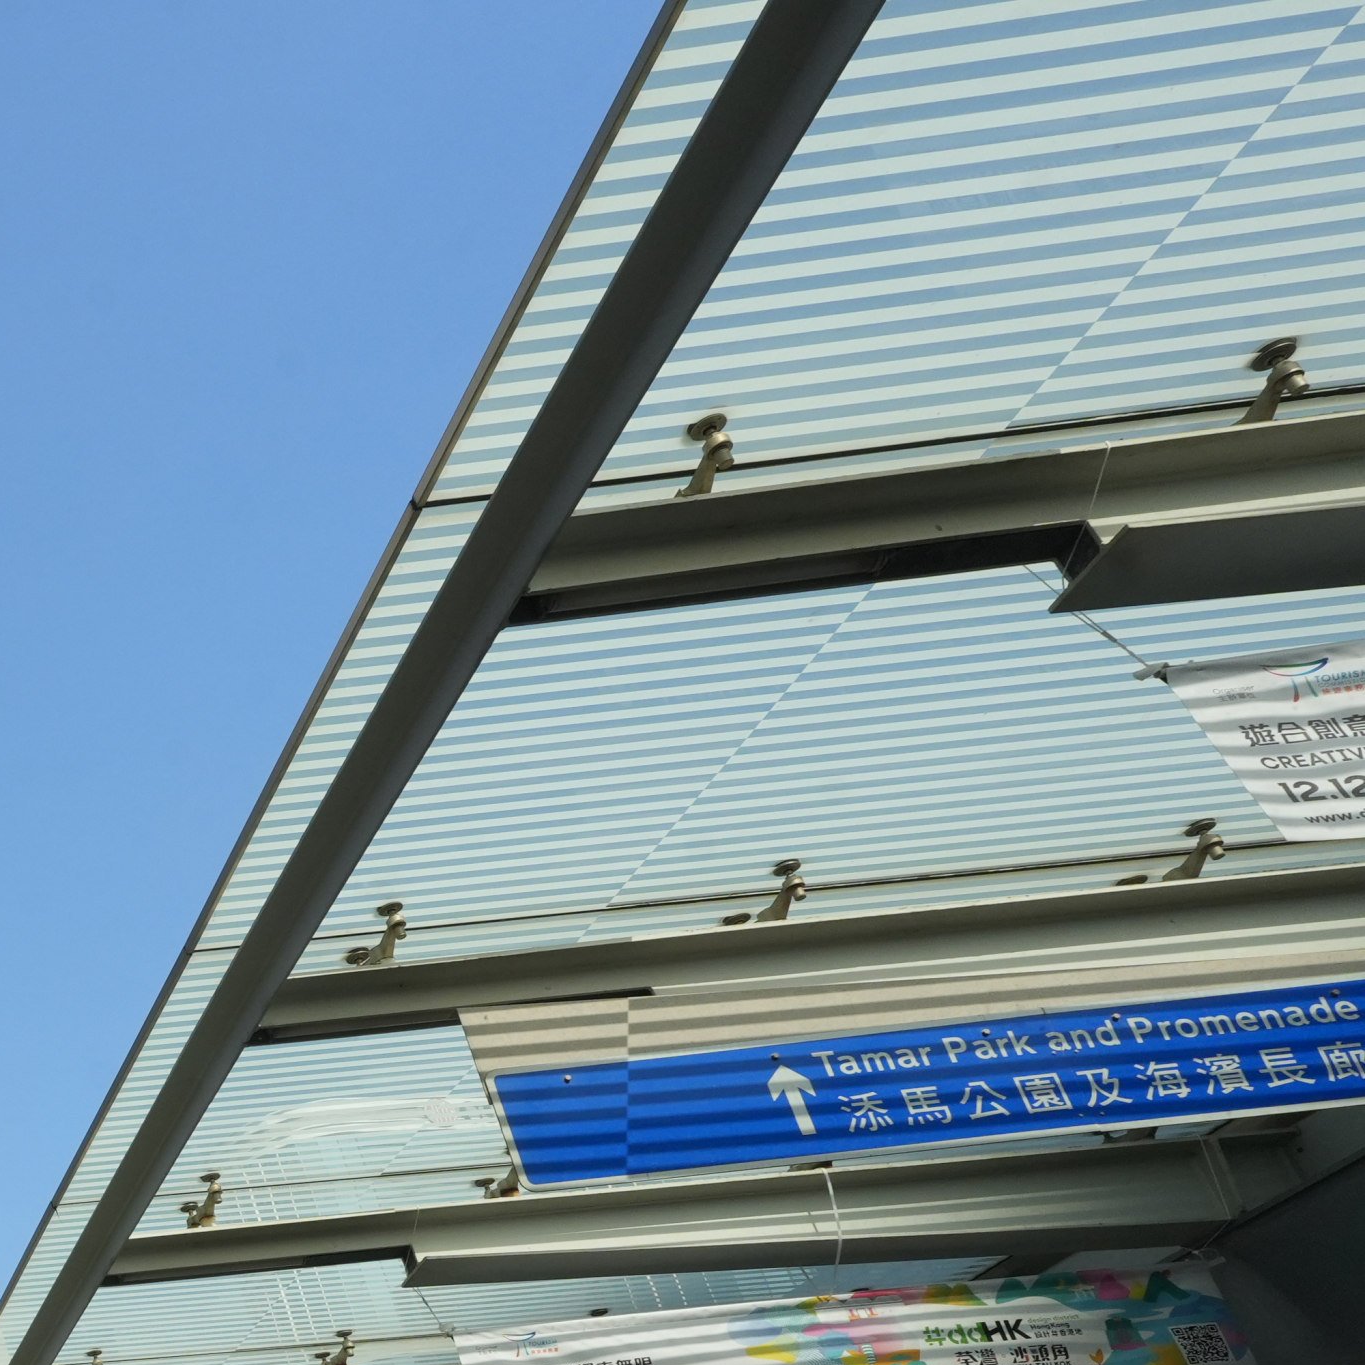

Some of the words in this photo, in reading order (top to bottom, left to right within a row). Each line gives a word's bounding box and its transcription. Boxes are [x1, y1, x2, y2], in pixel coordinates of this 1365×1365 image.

[811, 1046, 931, 1077] Tamar
[941, 1030, 1037, 1063] Park
[1045, 1019, 1121, 1052] and
[1126, 996, 1360, 1043] Promenade
[837, 1041, 1365, 1133] 添馬公園及海濱長廊
[923, 1318, 1031, 1347] #ddHK
[1009, 1344, 1070, 1364] 沙頭角
